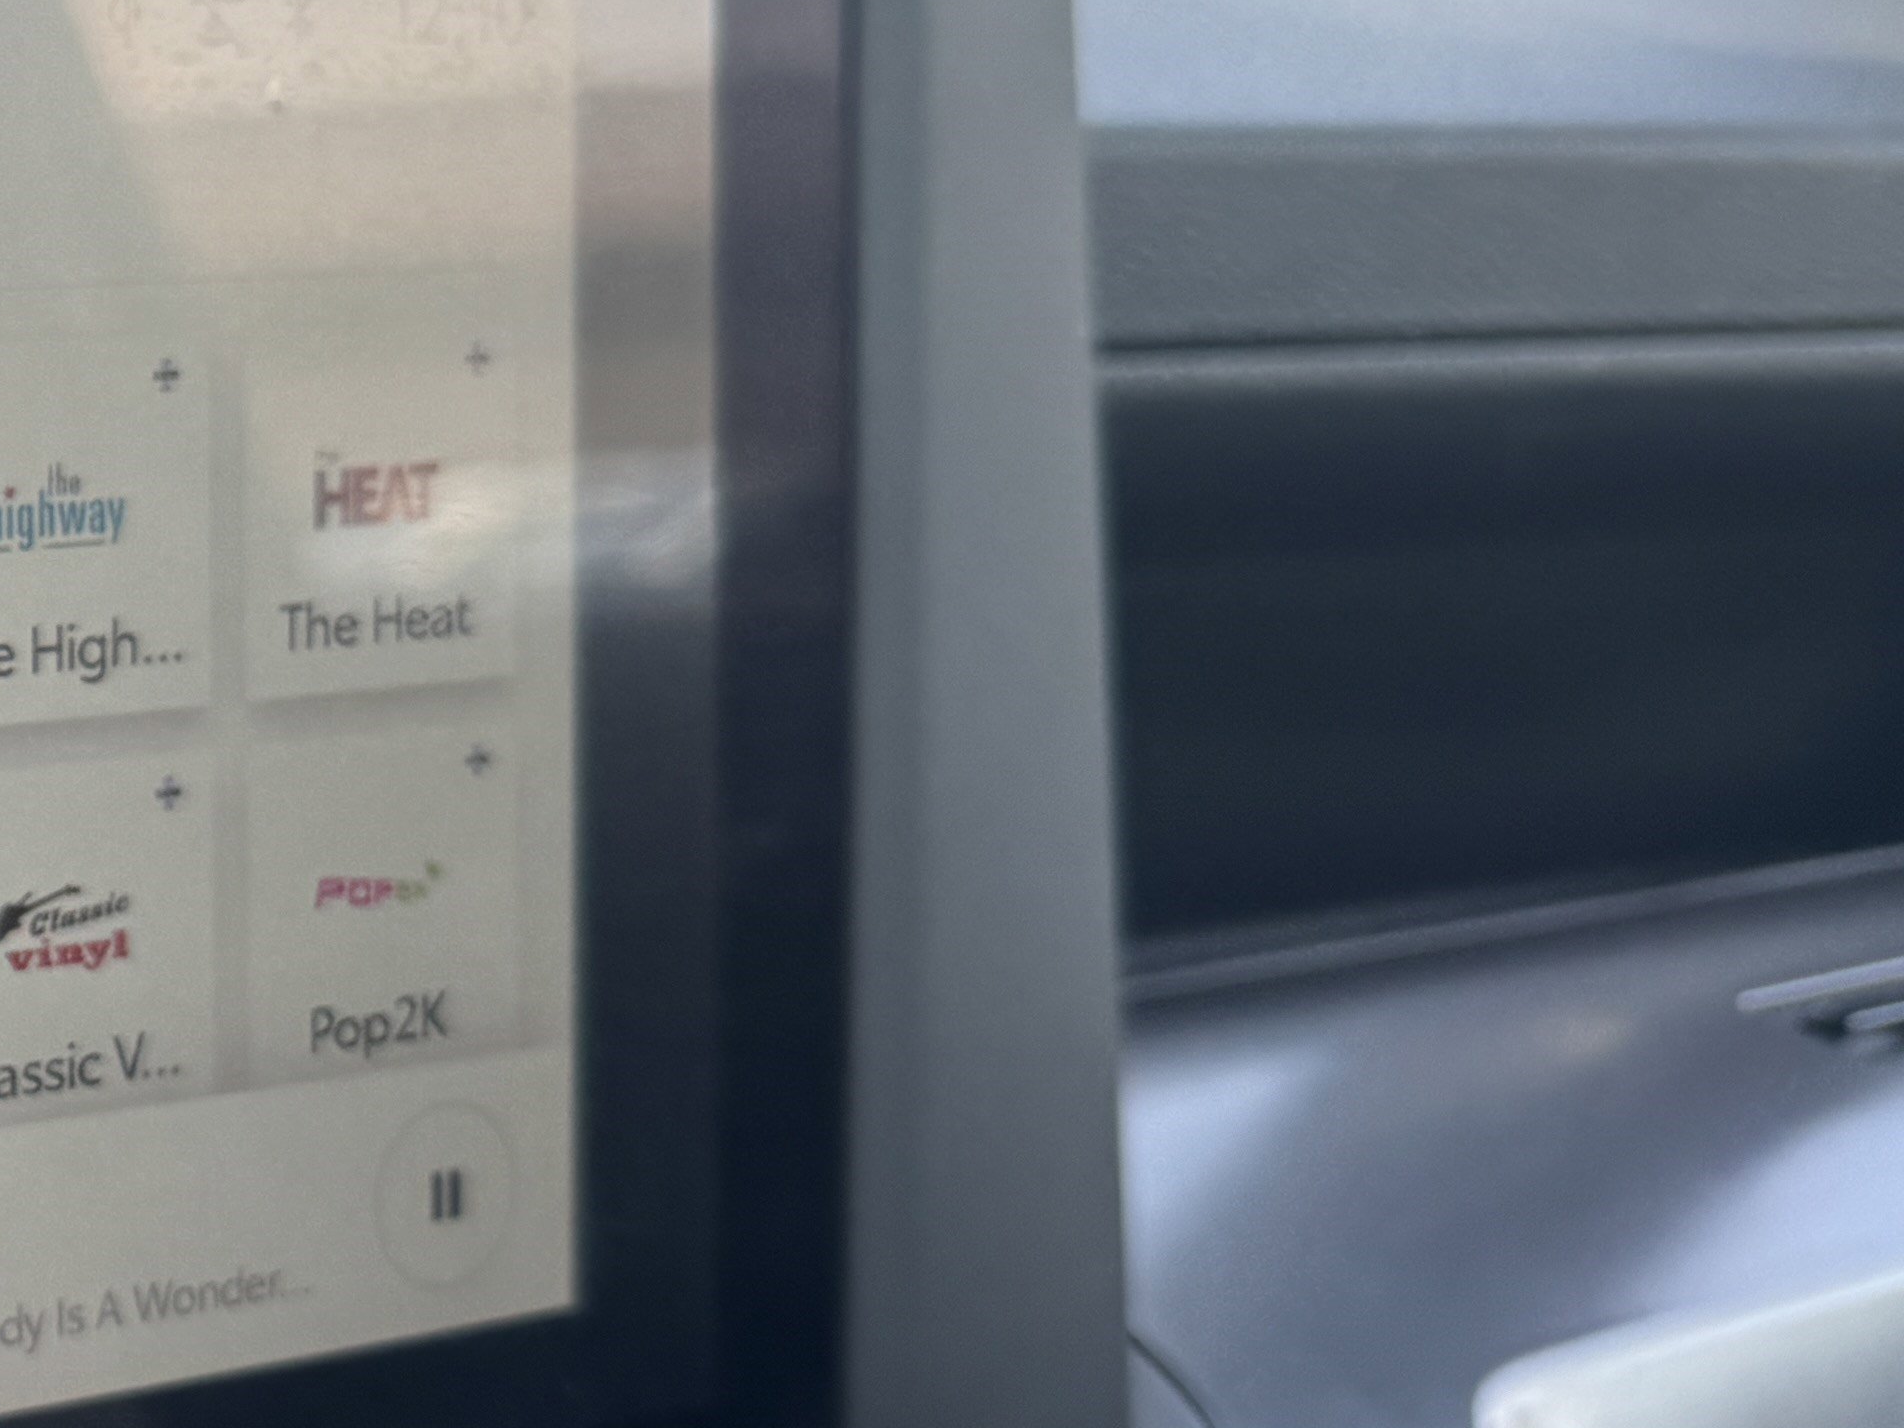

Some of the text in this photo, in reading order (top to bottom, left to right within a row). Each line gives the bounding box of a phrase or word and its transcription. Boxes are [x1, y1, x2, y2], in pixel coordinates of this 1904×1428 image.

[313, 462, 439, 532] HEAT
[280, 595, 474, 651] The Heat
[4, 928, 130, 971] vinyl
[310, 990, 449, 1060] Pop2K
[57, 1298, 85, 1337] Is
[96, 1291, 124, 1329] A
